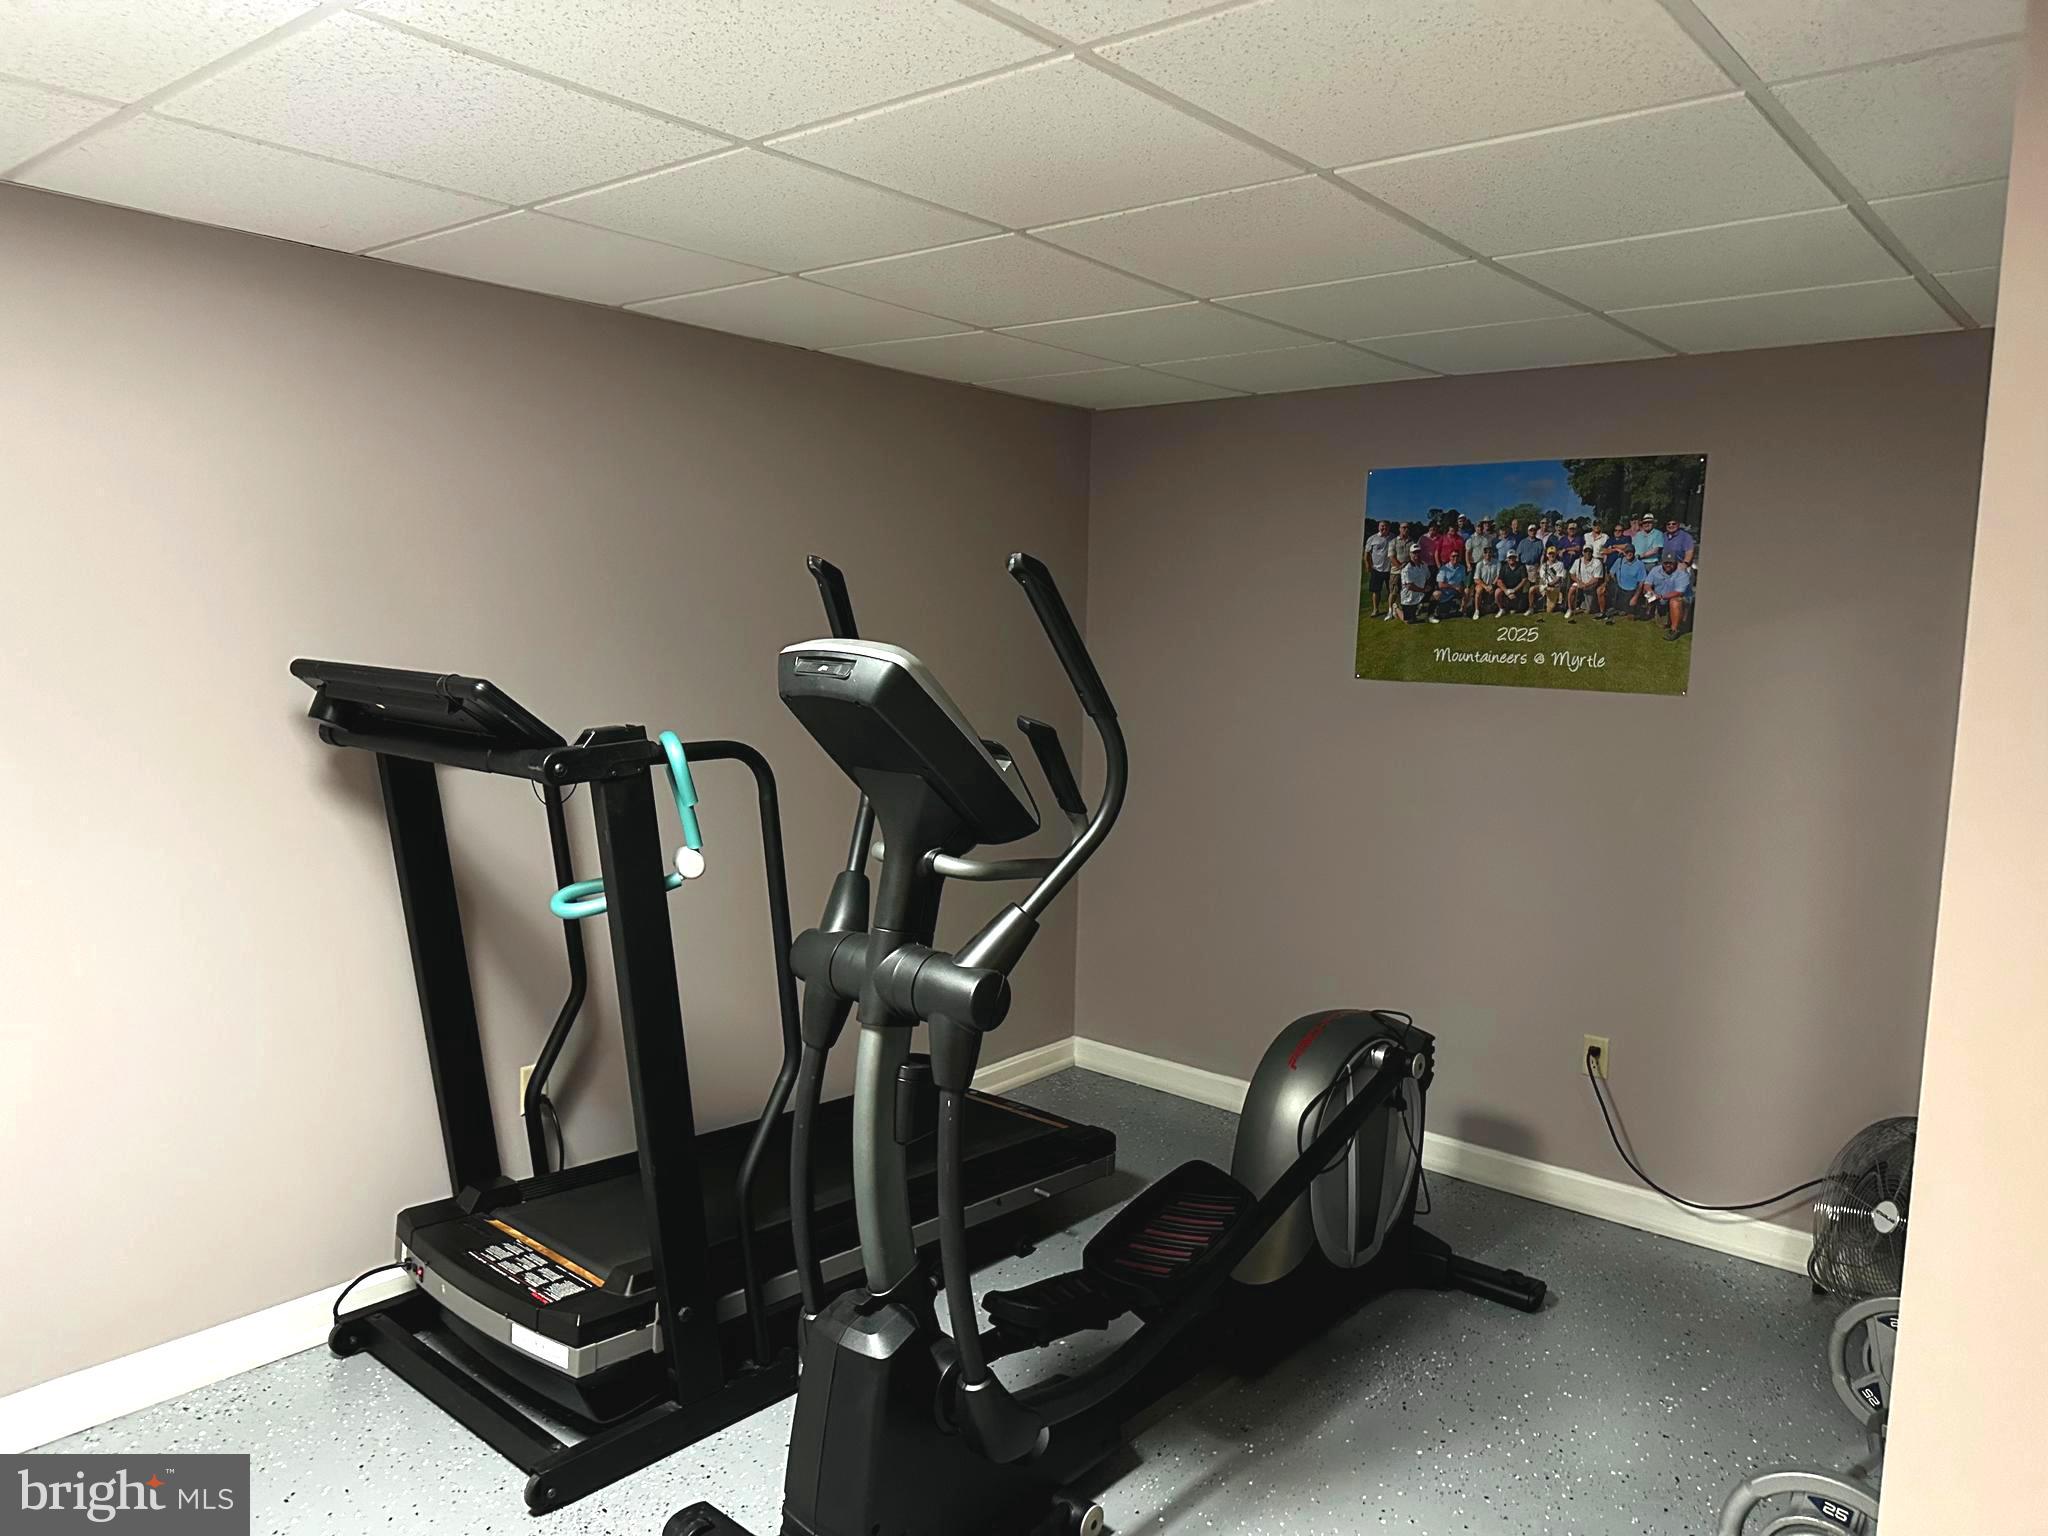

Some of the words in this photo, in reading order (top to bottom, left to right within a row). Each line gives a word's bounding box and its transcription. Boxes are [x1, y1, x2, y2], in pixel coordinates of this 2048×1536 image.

[1496, 626, 1539, 643] 2025
[1433, 647, 1527, 665] Mountaineers
[1533, 652, 1545, 665] @
[1551, 650, 1606, 673] Myrtle
[1861, 1388, 1880, 1407] 25
[1822, 1501, 1849, 1522] 25
